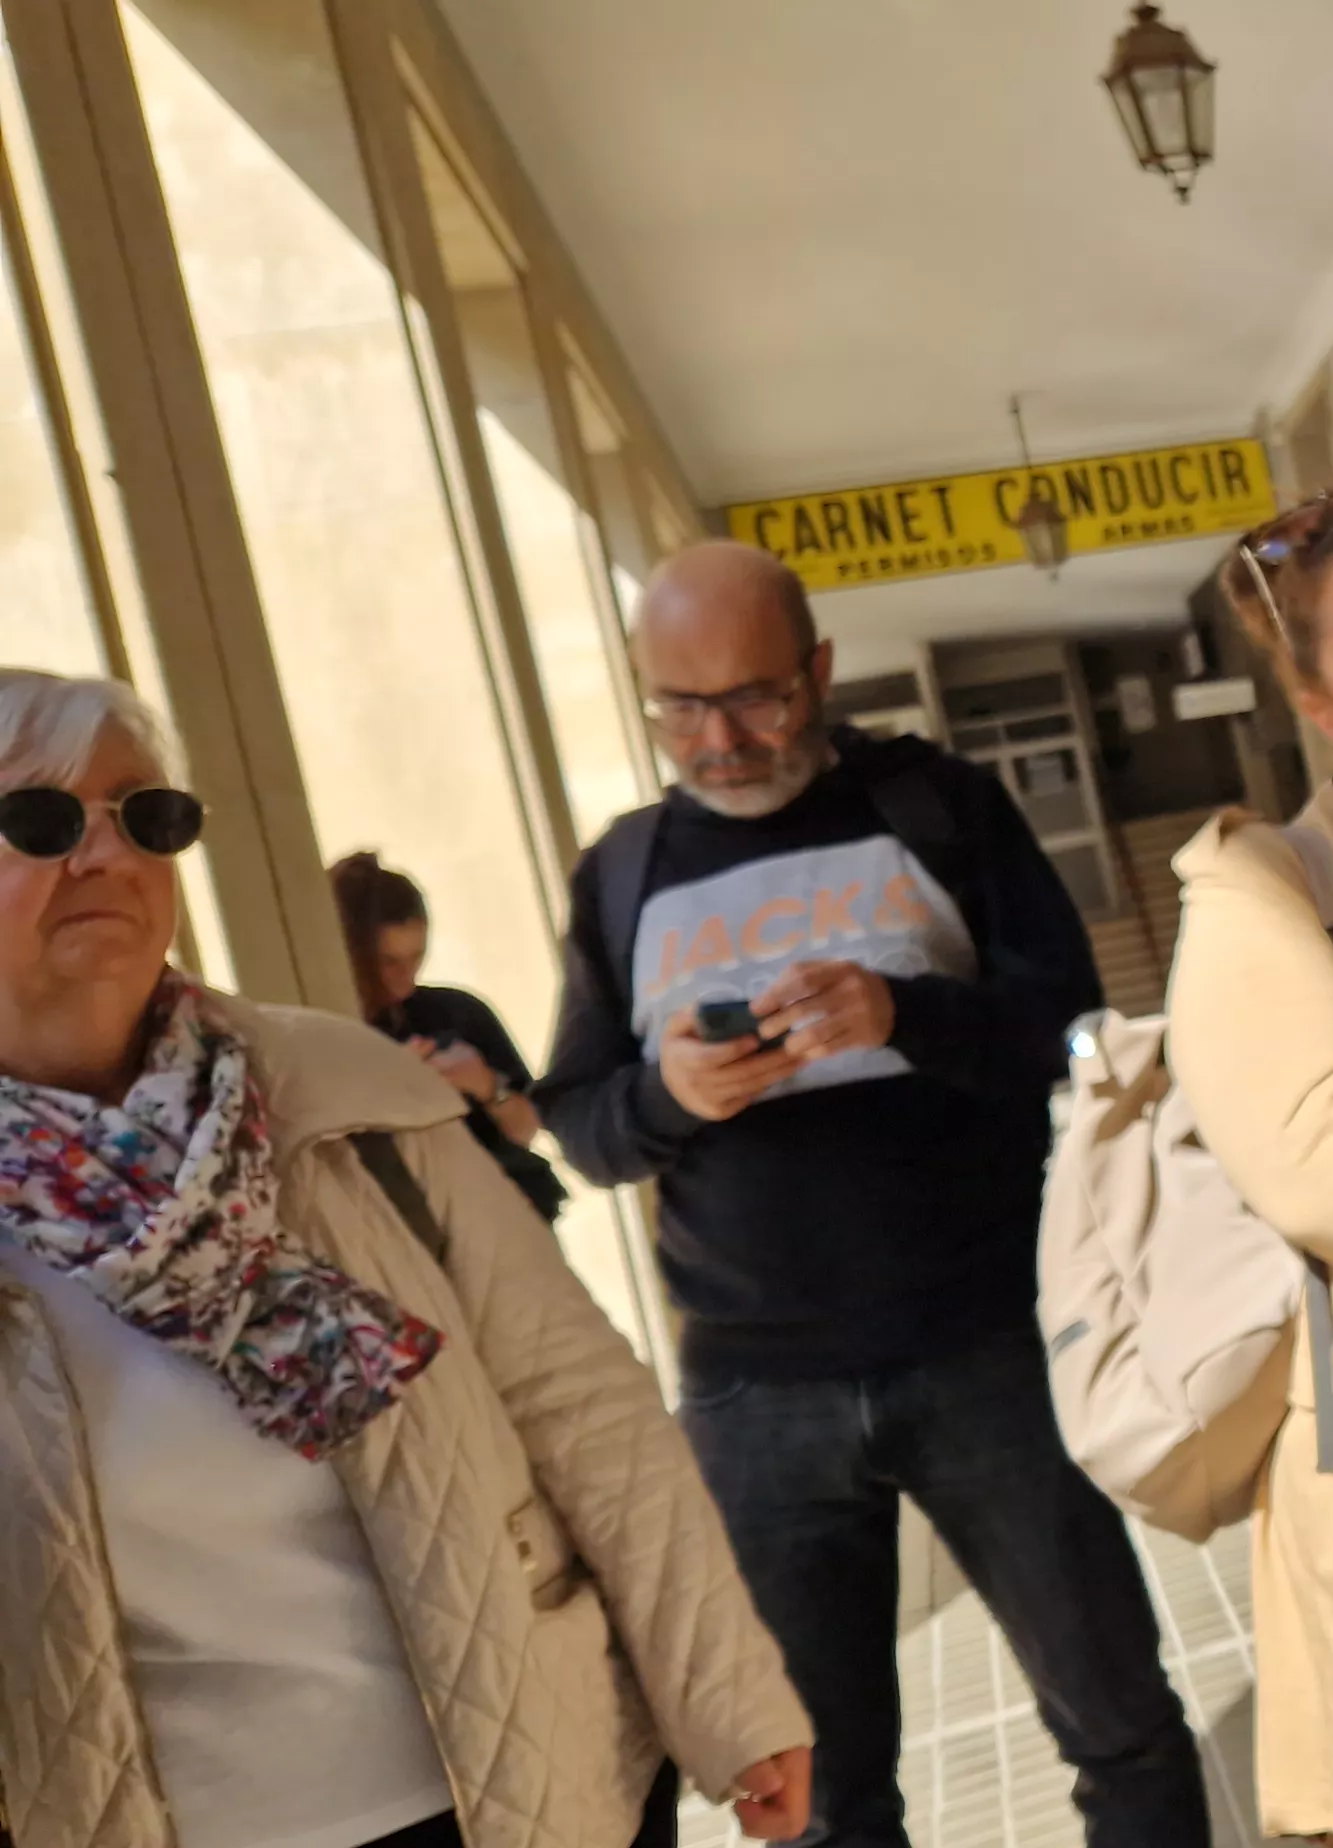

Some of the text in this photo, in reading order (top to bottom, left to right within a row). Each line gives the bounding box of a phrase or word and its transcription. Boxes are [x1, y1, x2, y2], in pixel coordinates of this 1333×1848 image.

[755, 486, 956, 562] CARNET
[837, 542, 996, 580] PERMISOS
[643, 881, 866, 994] JACK
